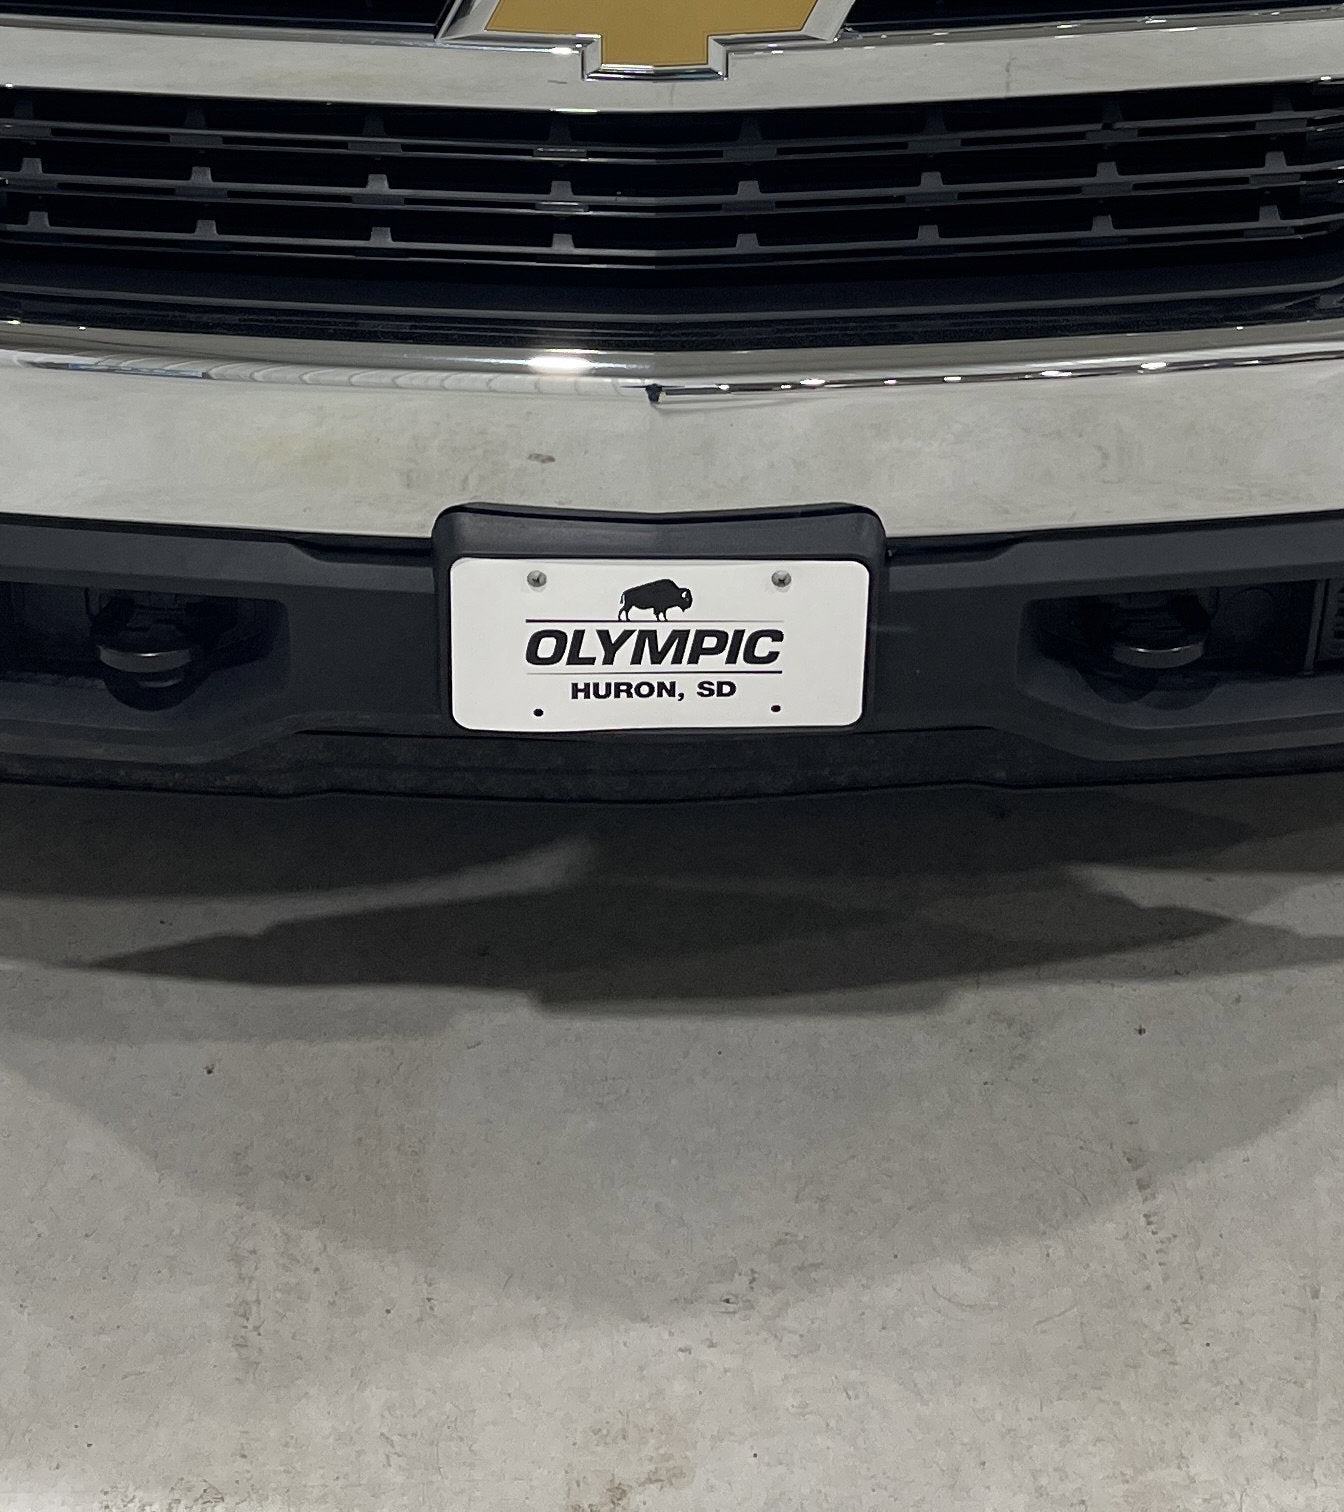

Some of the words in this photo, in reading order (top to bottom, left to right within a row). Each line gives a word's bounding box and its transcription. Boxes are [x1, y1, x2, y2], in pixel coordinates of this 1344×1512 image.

[525, 629, 784, 665] OLYMPIC
[571, 681, 685, 701] HURON,
[697, 680, 737, 698] SD
